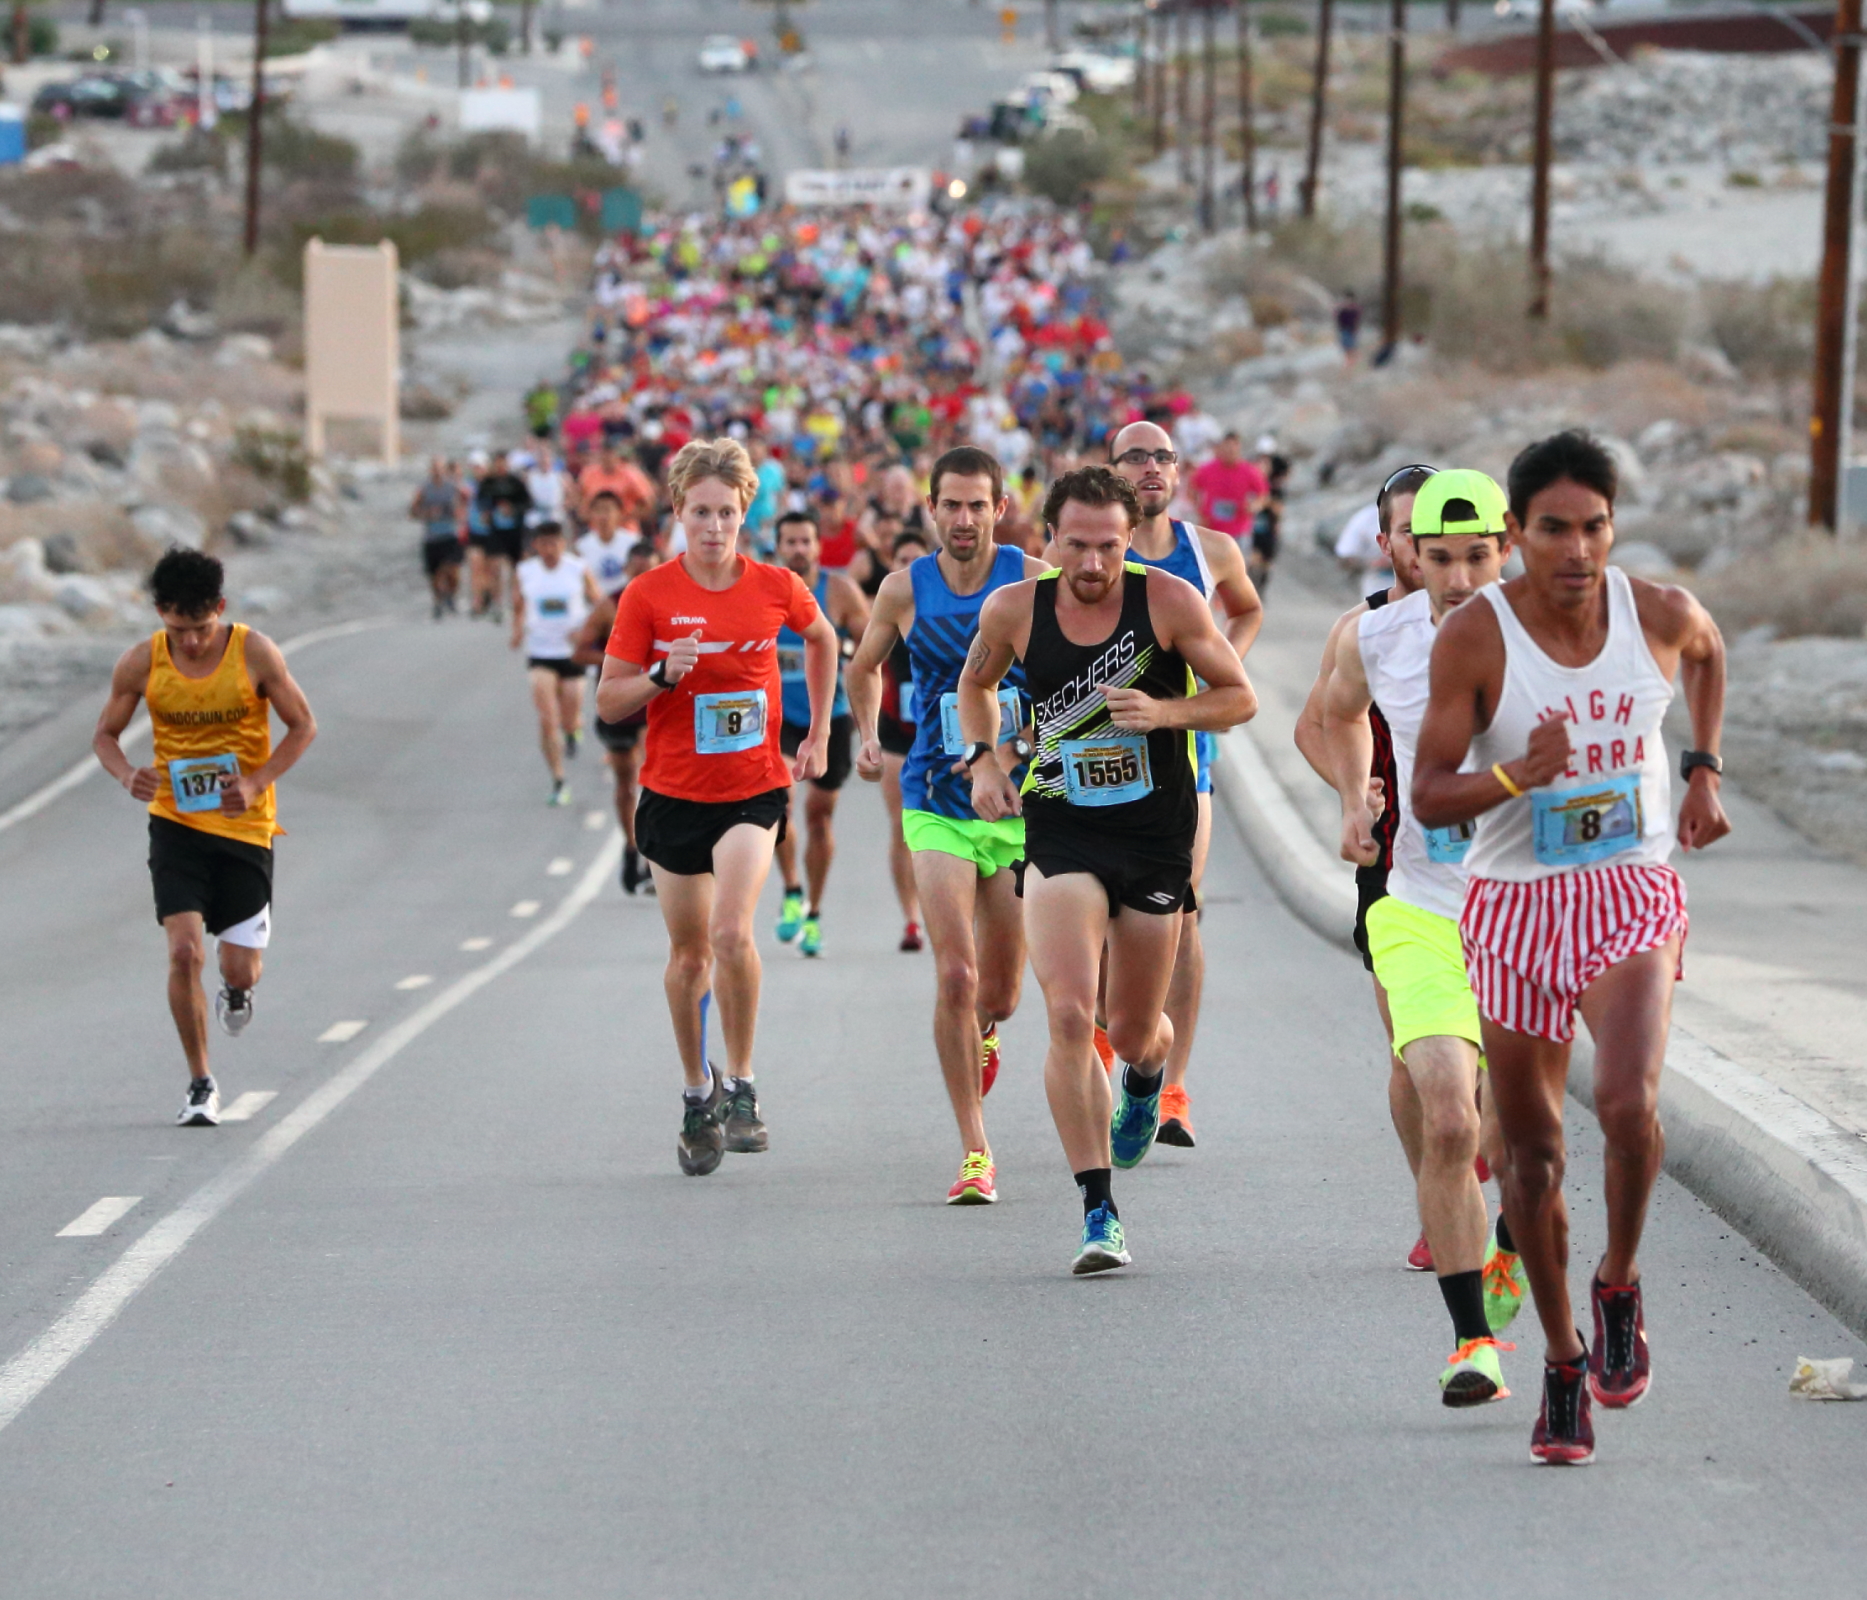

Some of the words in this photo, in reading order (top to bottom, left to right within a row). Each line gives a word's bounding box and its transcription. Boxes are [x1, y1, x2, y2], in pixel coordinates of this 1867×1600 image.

[671, 616, 707, 625] STRAVA
[1036, 630, 1135, 726] SKECHERS
[728, 711, 742, 736] 9
[1073, 754, 1138, 787] 1555
[1581, 809, 1601, 842] 8
